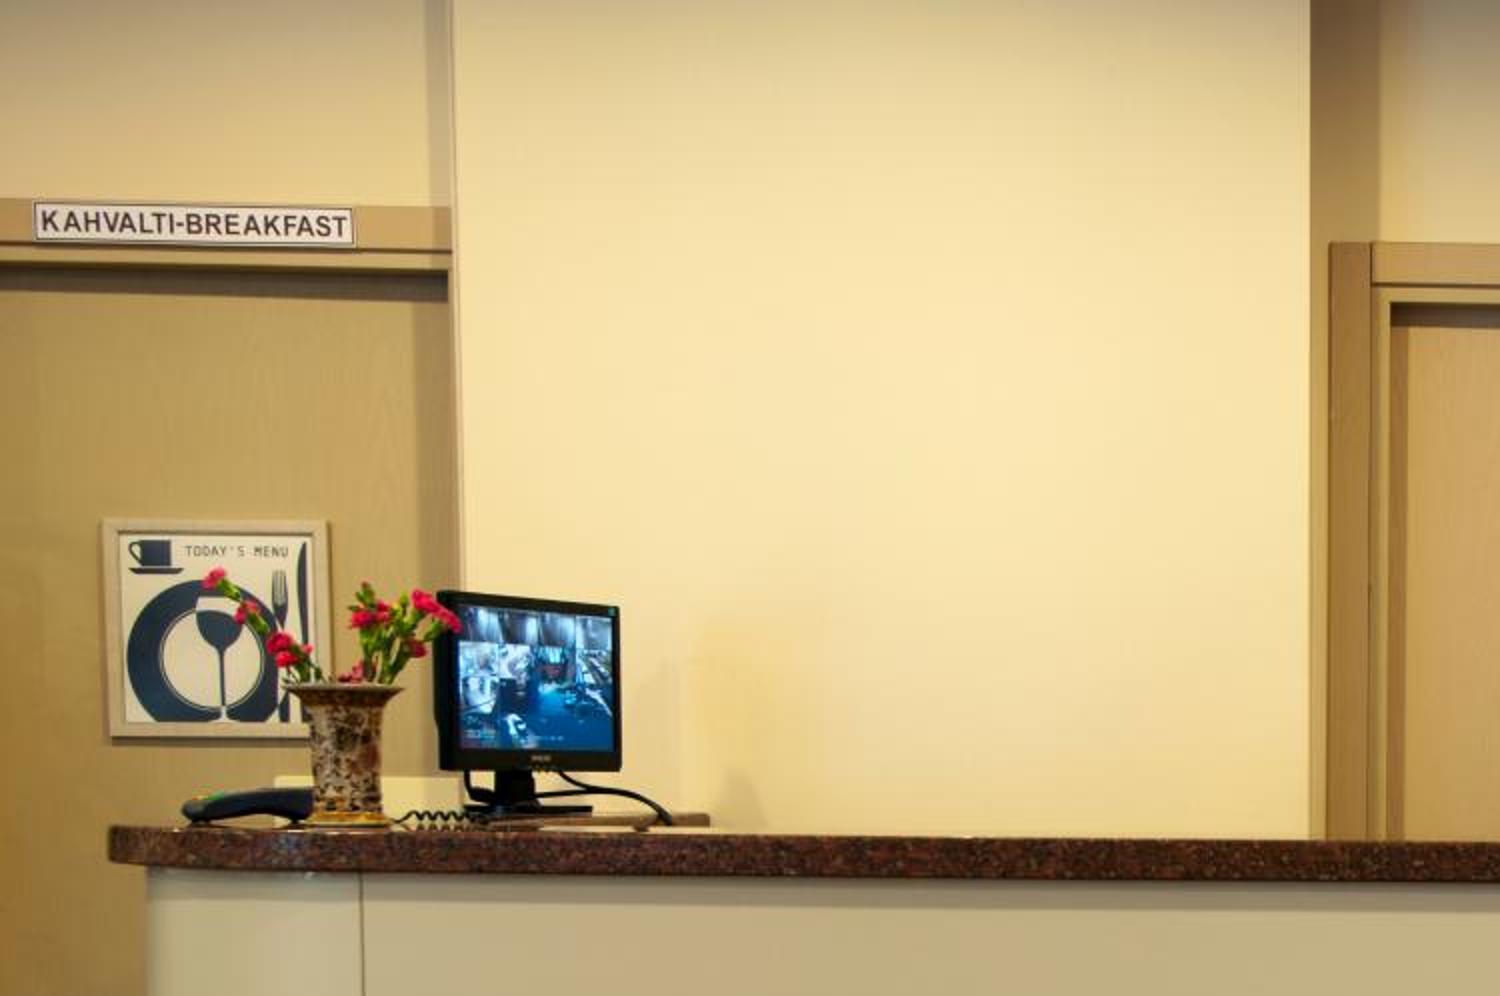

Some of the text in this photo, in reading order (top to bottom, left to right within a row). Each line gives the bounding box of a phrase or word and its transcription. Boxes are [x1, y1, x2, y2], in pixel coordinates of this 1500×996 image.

[41, 210, 347, 237] KAHVALTI-BREAKFAST
[185, 545, 288, 557] TODAY'S MENU
